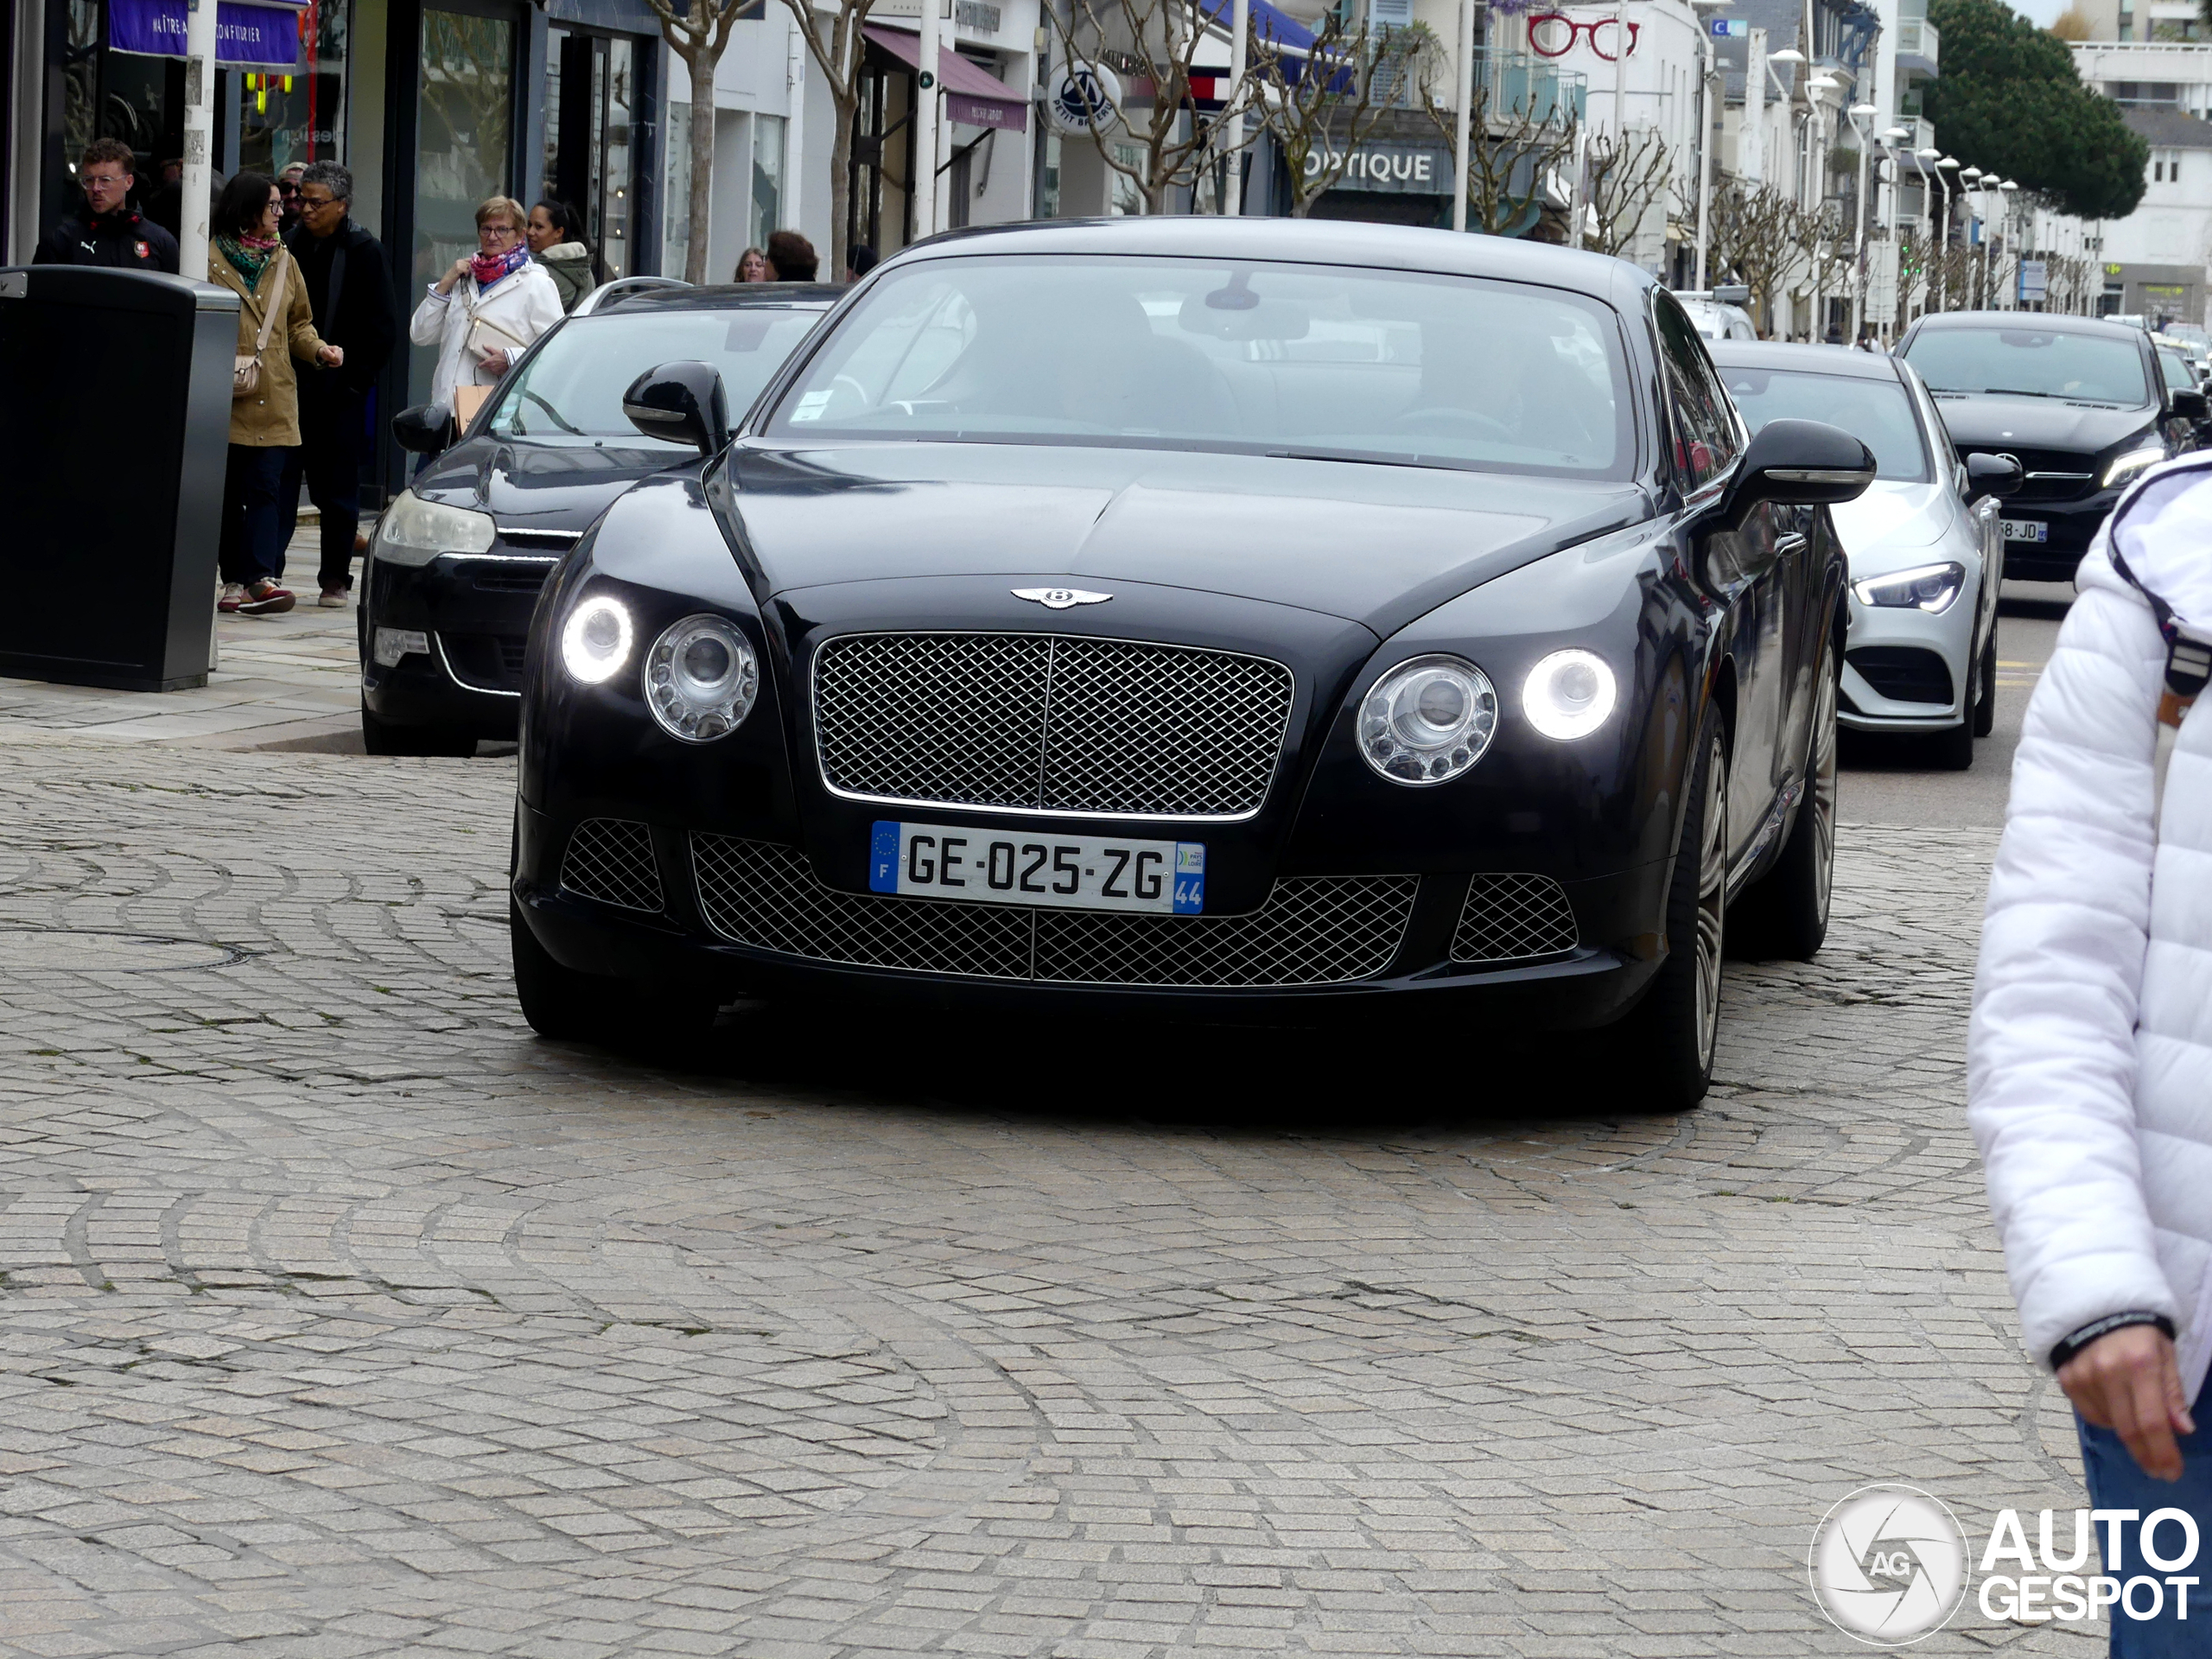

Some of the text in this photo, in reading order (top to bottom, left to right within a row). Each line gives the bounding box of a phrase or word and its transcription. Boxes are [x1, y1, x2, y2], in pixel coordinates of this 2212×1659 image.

[153, 14, 181, 35] MAÎTRE
[1052, 99, 1113, 126] PETIT BAEAU
[1304, 150, 1432, 182] OPTIQUE
[879, 864, 889, 878] F
[909, 835, 1163, 899] GE-025-ZG
[1175, 880, 1202, 906] 44
